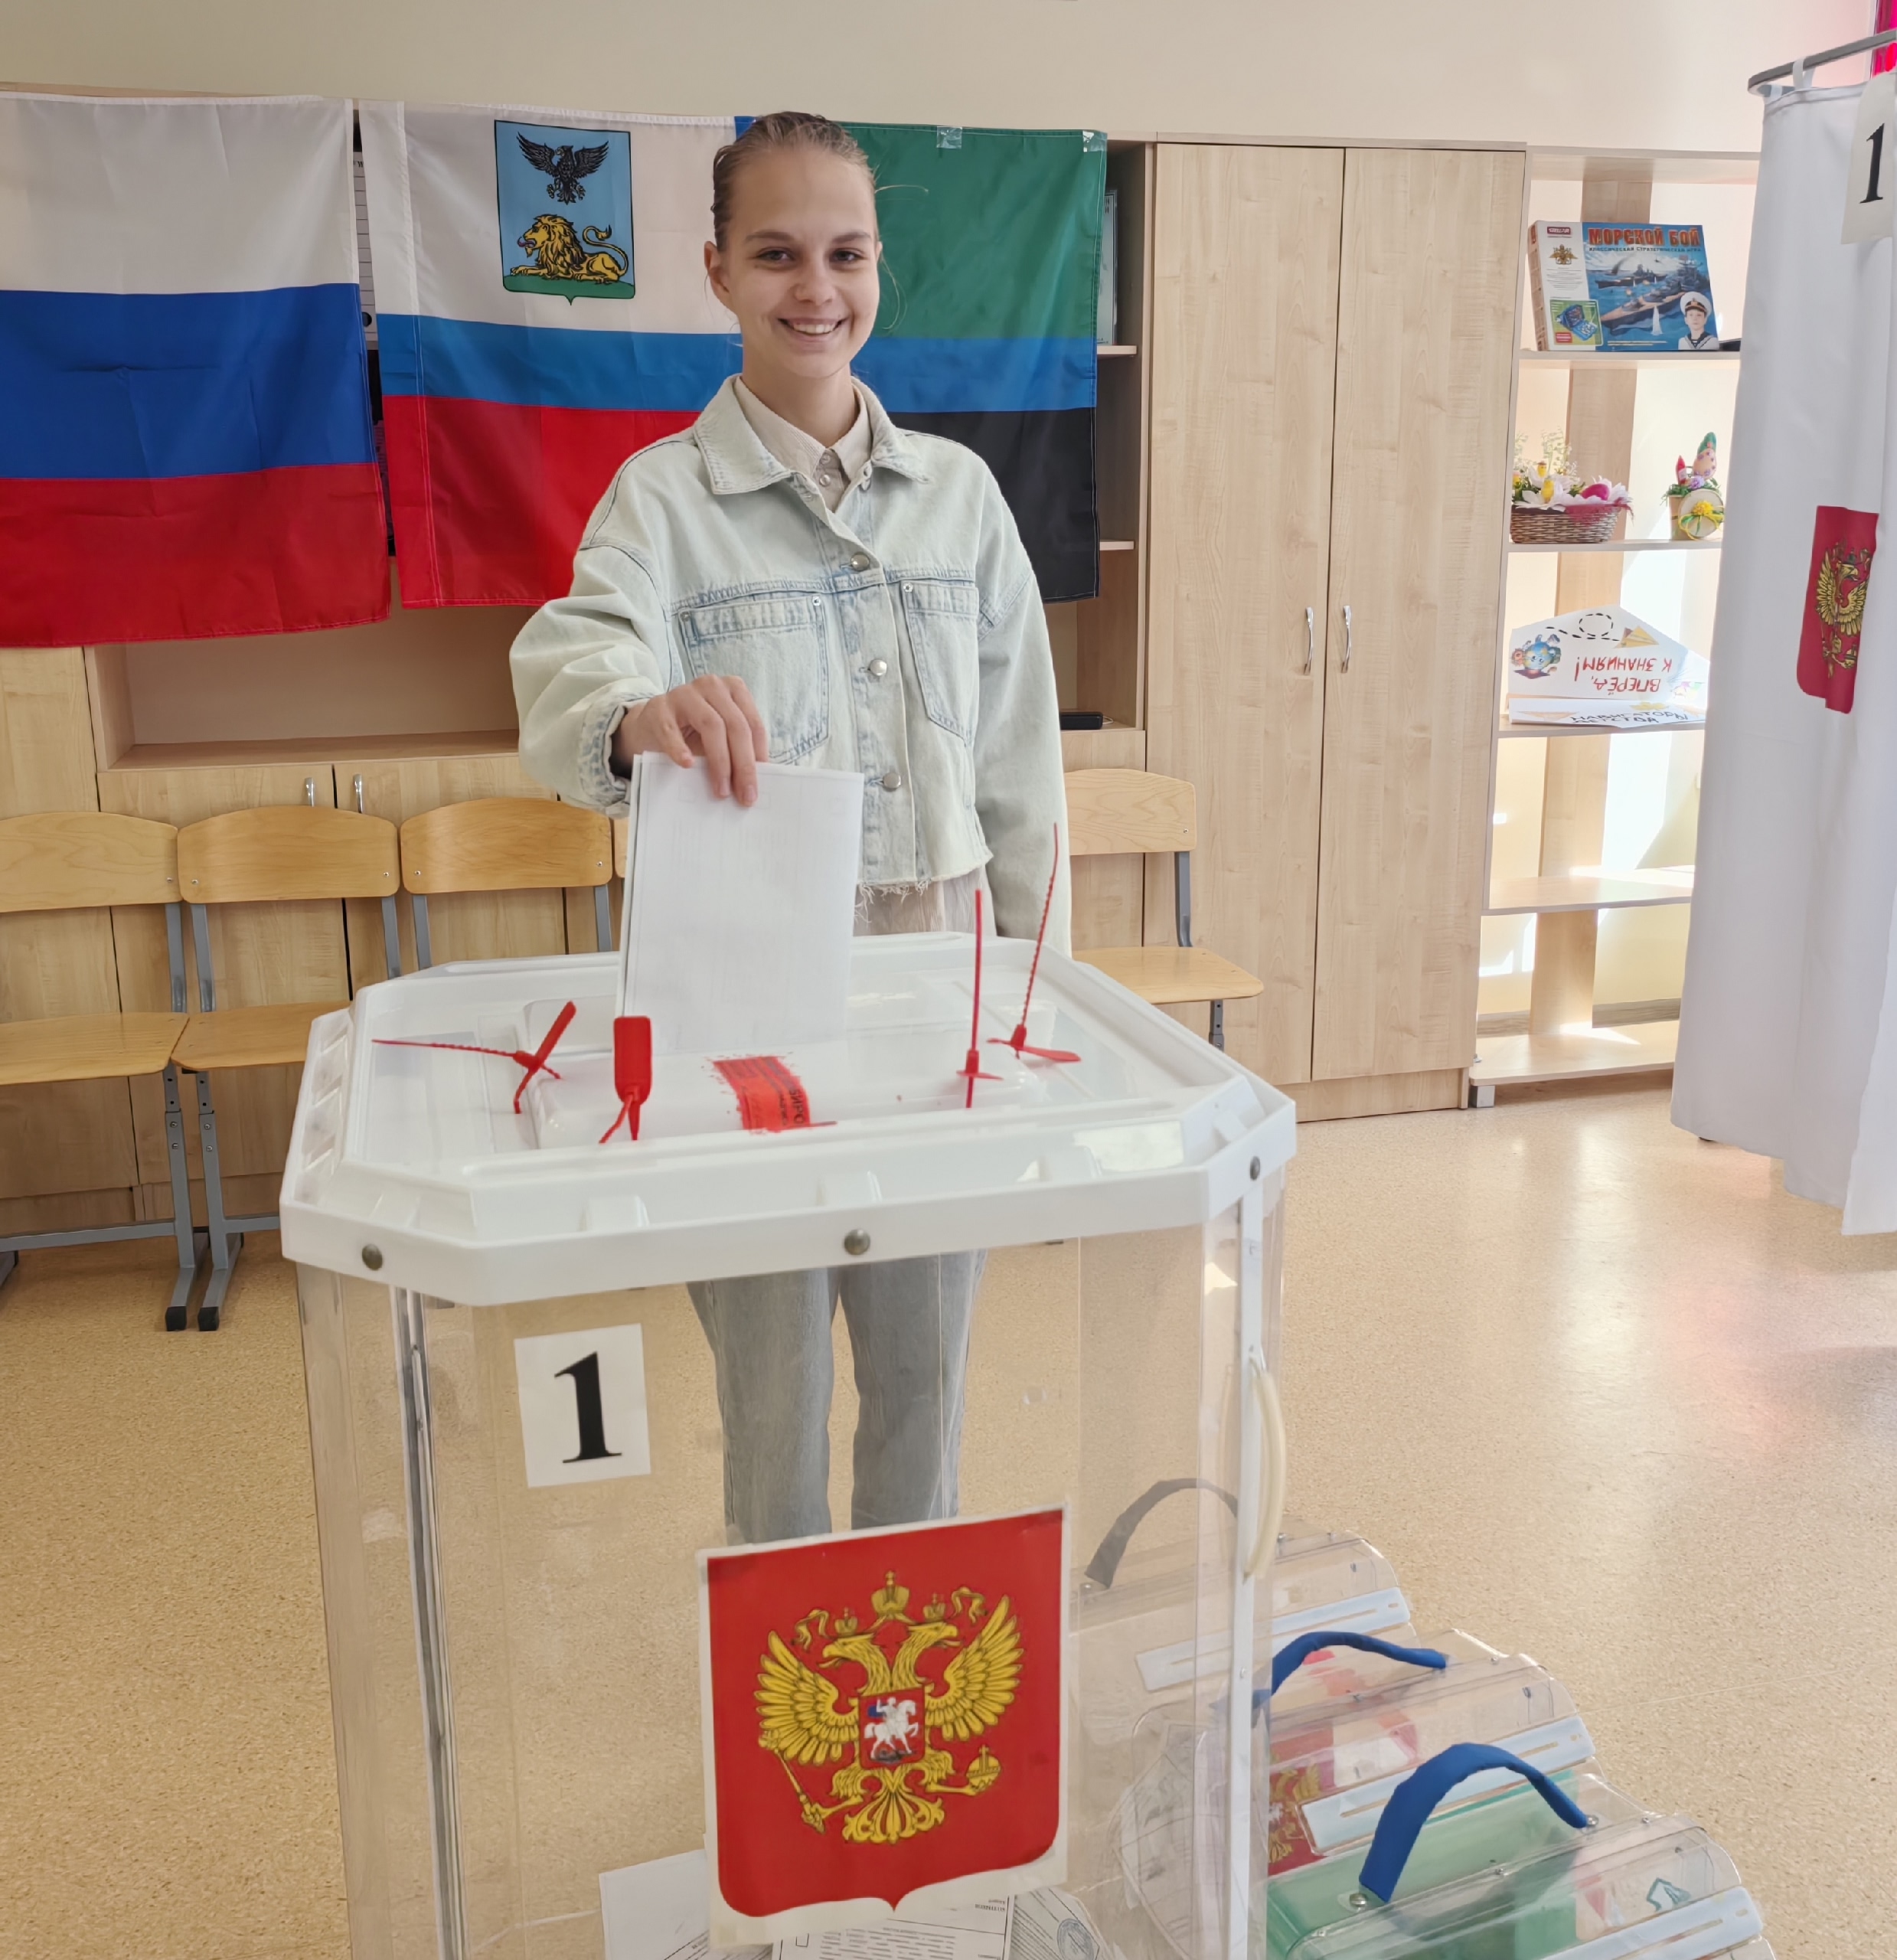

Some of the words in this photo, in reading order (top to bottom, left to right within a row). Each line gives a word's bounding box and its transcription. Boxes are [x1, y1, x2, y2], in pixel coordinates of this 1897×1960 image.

[1859, 122, 1885, 204] 1
[1588, 226, 1664, 245] МОРСКОЙ
[1669, 227, 1700, 247] БОЙ
[1574, 656, 1657, 681] ЗНАНИЯМ!
[1661, 658, 1673, 672] К
[553, 1350, 622, 1464] 1
